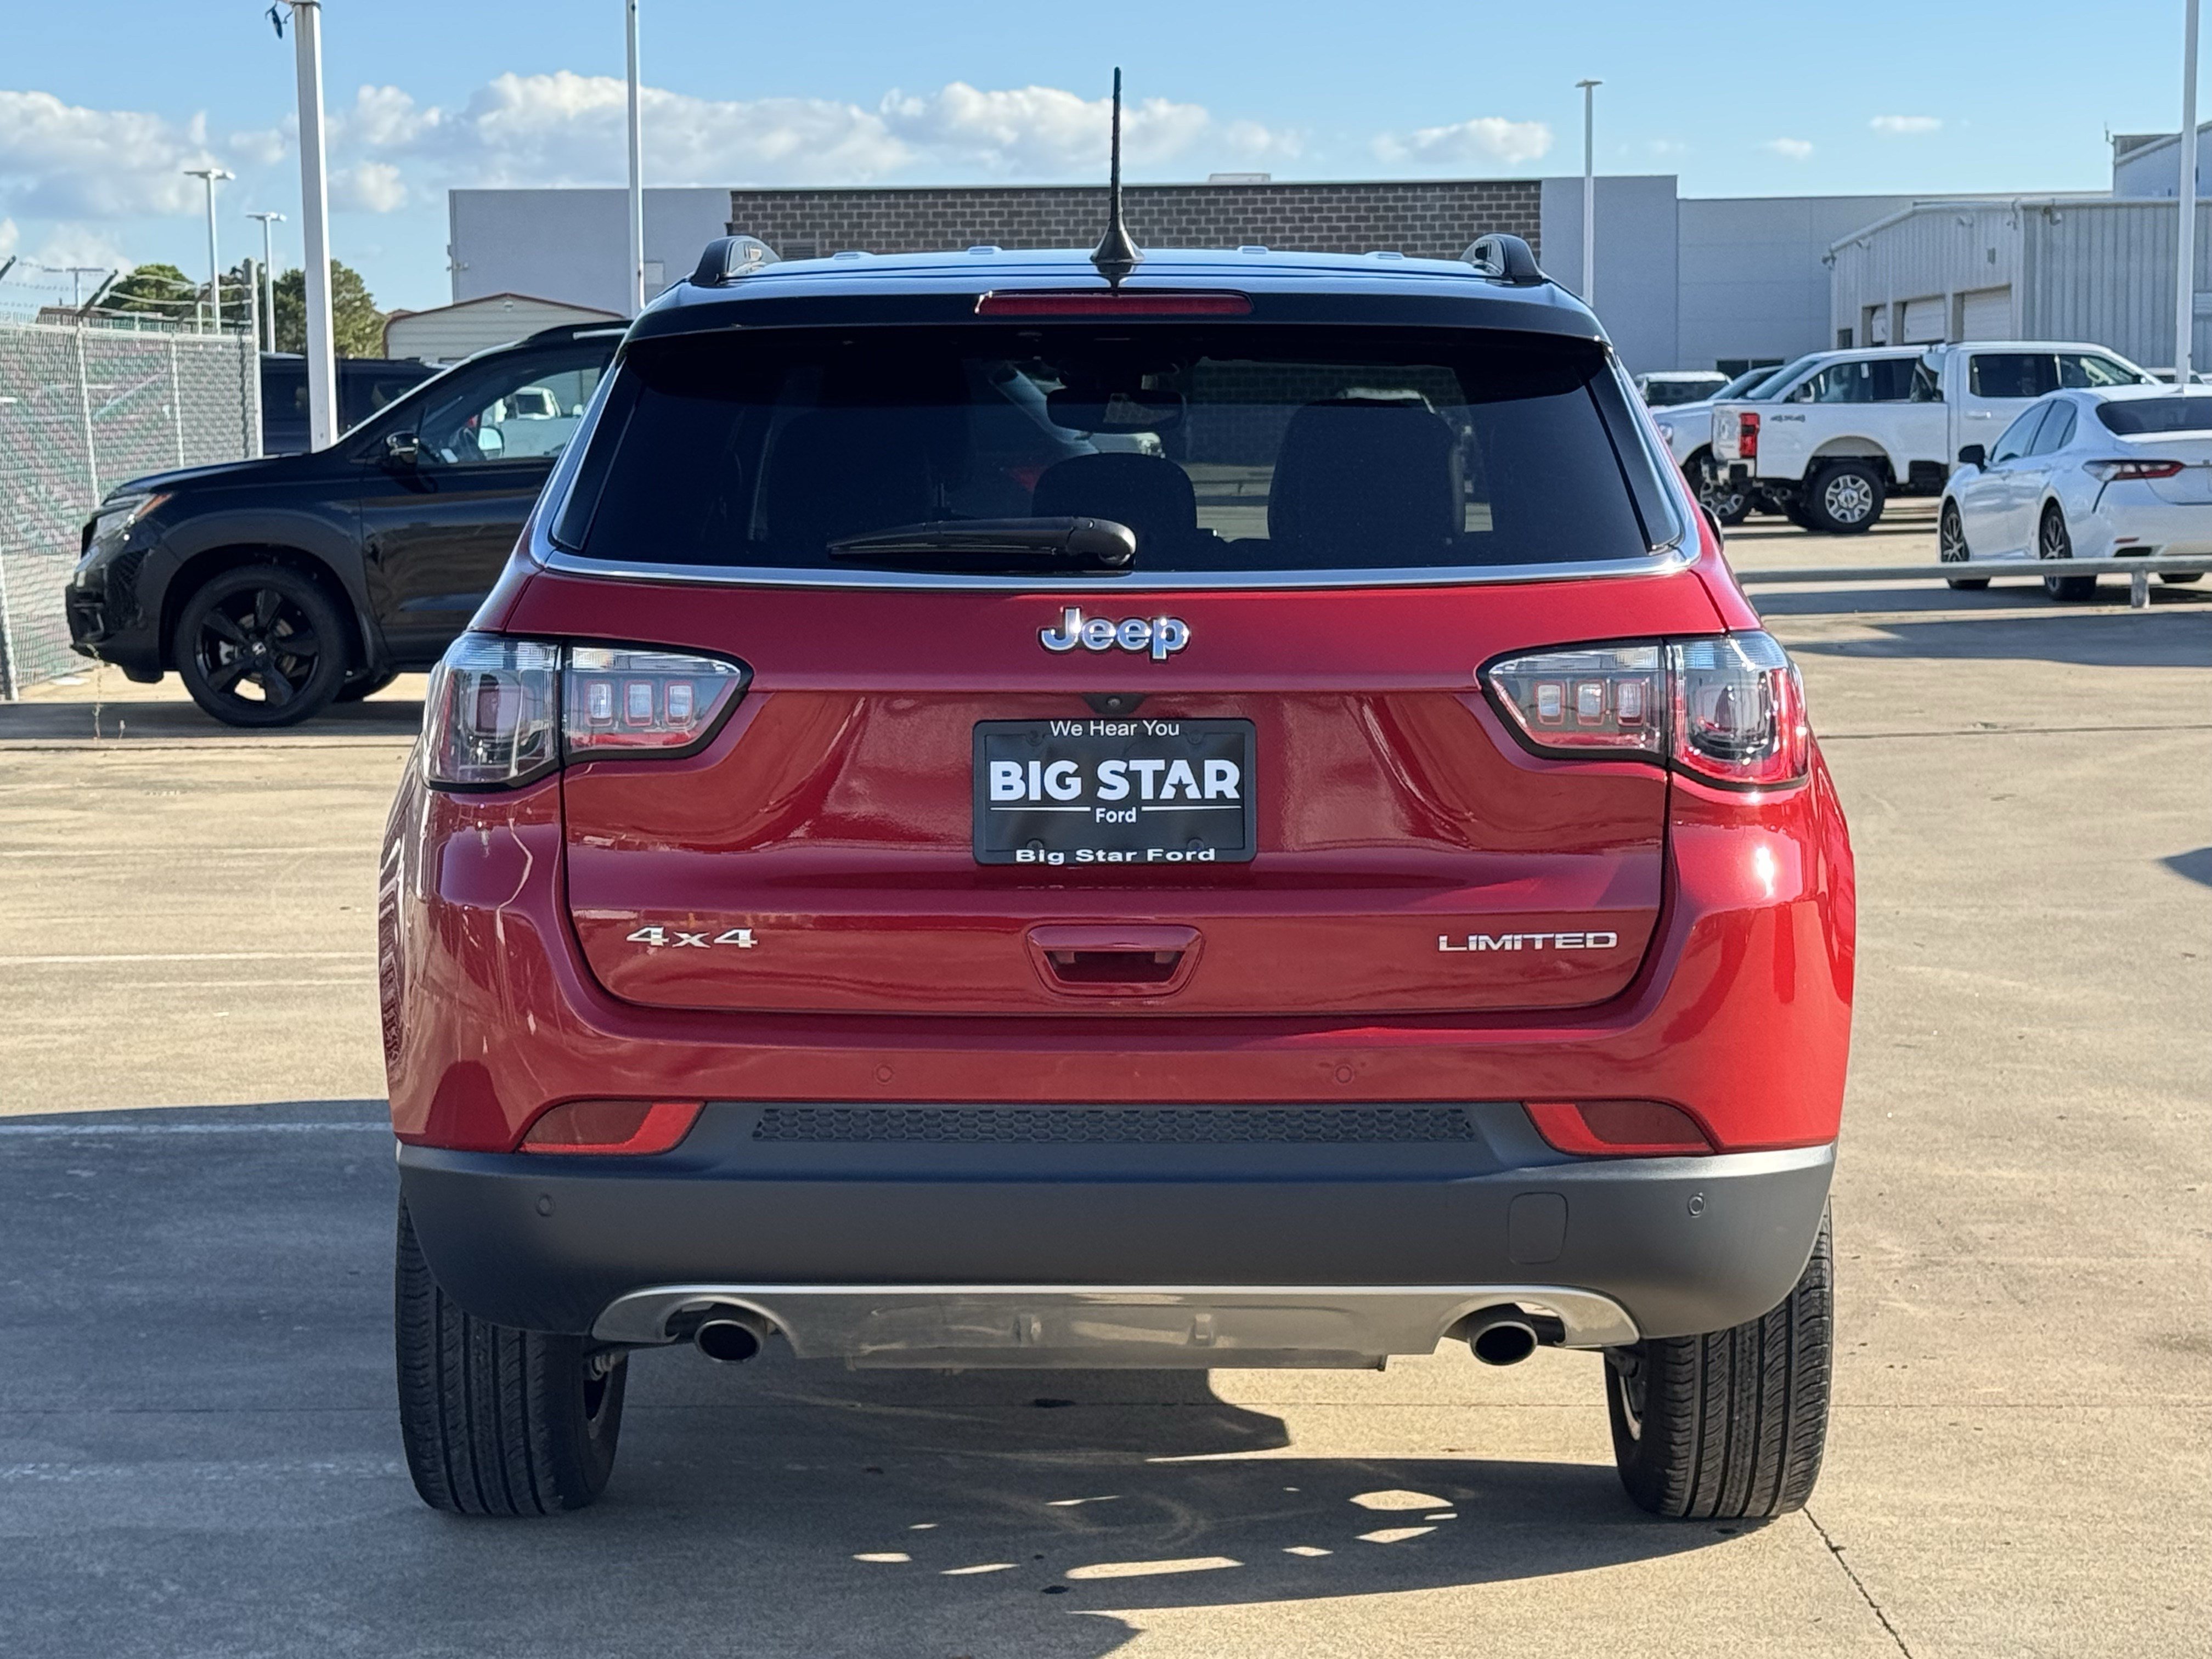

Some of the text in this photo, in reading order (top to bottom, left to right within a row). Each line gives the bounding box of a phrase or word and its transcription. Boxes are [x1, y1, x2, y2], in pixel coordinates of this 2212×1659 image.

[1041, 606, 1190, 661] Jeep
[1049, 720, 1180, 736] We Hear You
[990, 759, 1240, 801] BIG STAR
[1096, 807, 1137, 823] Ford
[1015, 848, 1216, 865] Big Star Ford
[625, 925, 758, 949] 4x4
[1438, 932, 1618, 951] LIMITED
